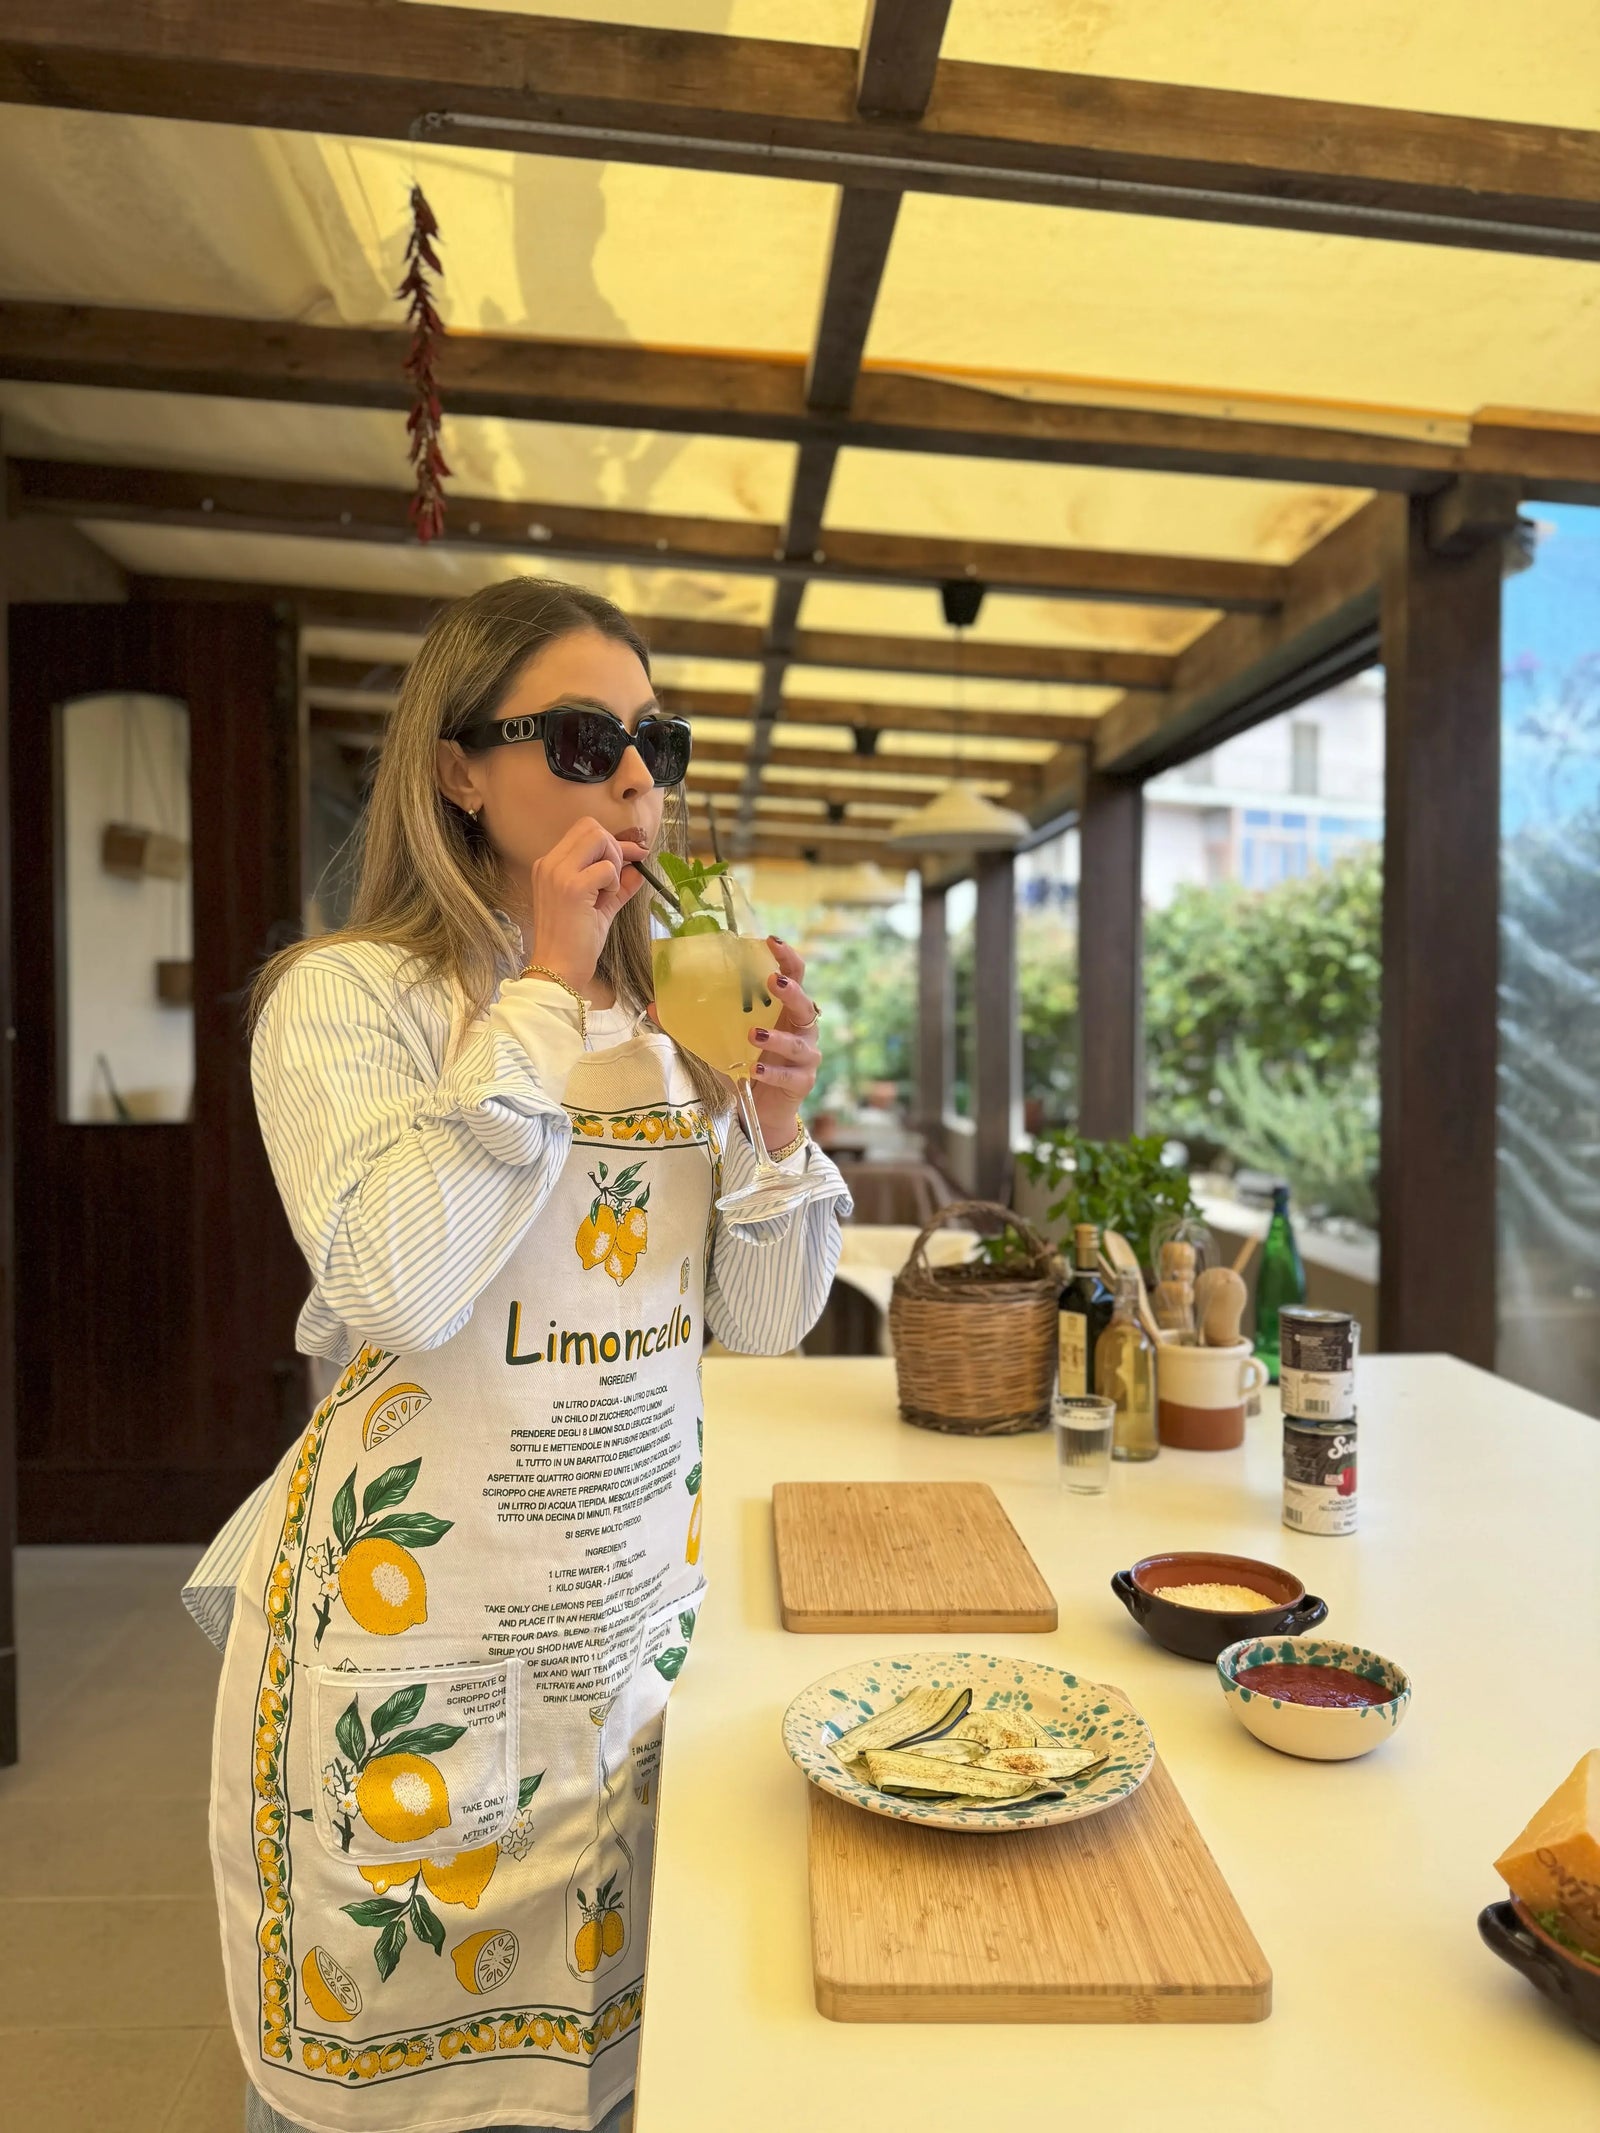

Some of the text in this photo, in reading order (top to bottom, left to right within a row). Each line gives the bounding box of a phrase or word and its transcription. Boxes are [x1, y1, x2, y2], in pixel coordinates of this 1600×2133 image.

[505, 1299, 691, 1366] Limoncello
[553, 1385, 668, 1409] UN LITRO D'ACQUA UN LITRO D'ALCOOL
[552, 1415, 563, 1423] UN
[565, 1414, 588, 1423] CHILO
[590, 1414, 598, 1422] DI
[646, 1399, 662, 1411] LIMONI
[511, 1429, 556, 1438] PRENDERE
[558, 1429, 580, 1437] DEGLI
[583, 1428, 587, 1436] 8
[589, 1426, 613, 1436] LIMONI
[510, 1444, 541, 1452] SOTTILI
[543, 1444, 548, 1452] E
[550, 1441, 602, 1452] METTENDOLE
[603, 1440, 610, 1448] IN
[516, 1459, 523, 1467] IL
[525, 1458, 551, 1467] TUTTO
[554, 1458, 562, 1467] IN
[564, 1457, 575, 1466] UN
[576, 1452, 618, 1466] BARATTOLO
[487, 1473, 534, 1483] ASPETTATE
[536, 1473, 574, 1483] QUATTRO
[576, 1470, 602, 1481] GIORNI
[603, 1468, 613, 1478] ED
[614, 1464, 630, 1475] UNITE
[482, 1488, 526, 1497] SCIROPPO
[528, 1489, 545, 1497] CHE
[546, 1487, 577, 1497] AVRETE
[579, 1481, 620, 1495] PREPARATO
[620, 1478, 632, 1489] CON
[633, 1475, 640, 1484] UN
[498, 1502, 510, 1510] UN
[512, 1502, 536, 1510] LITRO
[538, 1502, 547, 1510] DI
[548, 1501, 577, 1510] ACQUA
[608, 1487, 640, 1504] MESCOLATE
[497, 1514, 524, 1522] TUTTO
[526, 1513, 544, 1522] UNA
[546, 1513, 576, 1522] DECINA
[577, 1512, 585, 1520] DI
[613, 1500, 636, 1514] FILTRATE
[565, 1531, 573, 1539] SI
[575, 1528, 600, 1538] SERVE
[601, 1523, 622, 1534] MOLTO
[585, 1540, 627, 1557] INGREDIENTS
[555, 1568, 577, 1578] LITRE
[556, 1584, 574, 1592] KILO
[575, 1579, 602, 1590] SUGAR
[484, 1605, 505, 1613] TAKE
[507, 1605, 530, 1613] ONLY
[532, 1604, 549, 1612] CHE
[551, 1601, 584, 1611] LEMONS
[499, 1619, 516, 1627] AND
[518, 1616, 545, 1627] PLACE
[547, 1616, 554, 1624] IT
[556, 1615, 564, 1623] IN
[566, 1614, 577, 1624] AN
[482, 1633, 509, 1642] AFTER
[511, 1632, 534, 1642] FOUR
[564, 1627, 590, 1637] BLEND
[594, 1624, 607, 1634] THE
[488, 1647, 514, 1656] SIRUP
[515, 1647, 535, 1656] YOU
[536, 1643, 562, 1654] SHOD
[562, 1641, 584, 1650] HAVE
[540, 1657, 569, 1667] SUGAR
[570, 1654, 590, 1664] INTO
[533, 1671, 548, 1679] MIX
[550, 1669, 568, 1678] AND
[570, 1667, 591, 1678] WAIT
[593, 1664, 607, 1674] TEN
[450, 1677, 497, 1693] ASPETTATE
[536, 1682, 575, 1690] FILTRATE
[576, 1680, 594, 1689] AND
[595, 1676, 610, 1686] PUT
[446, 1692, 490, 1706] SCIROPPO
[543, 1695, 568, 1703] DRINK
[463, 1706, 476, 1715] UN
[477, 1699, 500, 1713] LITRO
[467, 1715, 494, 1728] TUTTO
[461, 1801, 482, 1814] TAKE
[484, 1796, 504, 1808] ONLY
[478, 1813, 494, 1824] AND
[462, 1827, 489, 1841] AFTER
